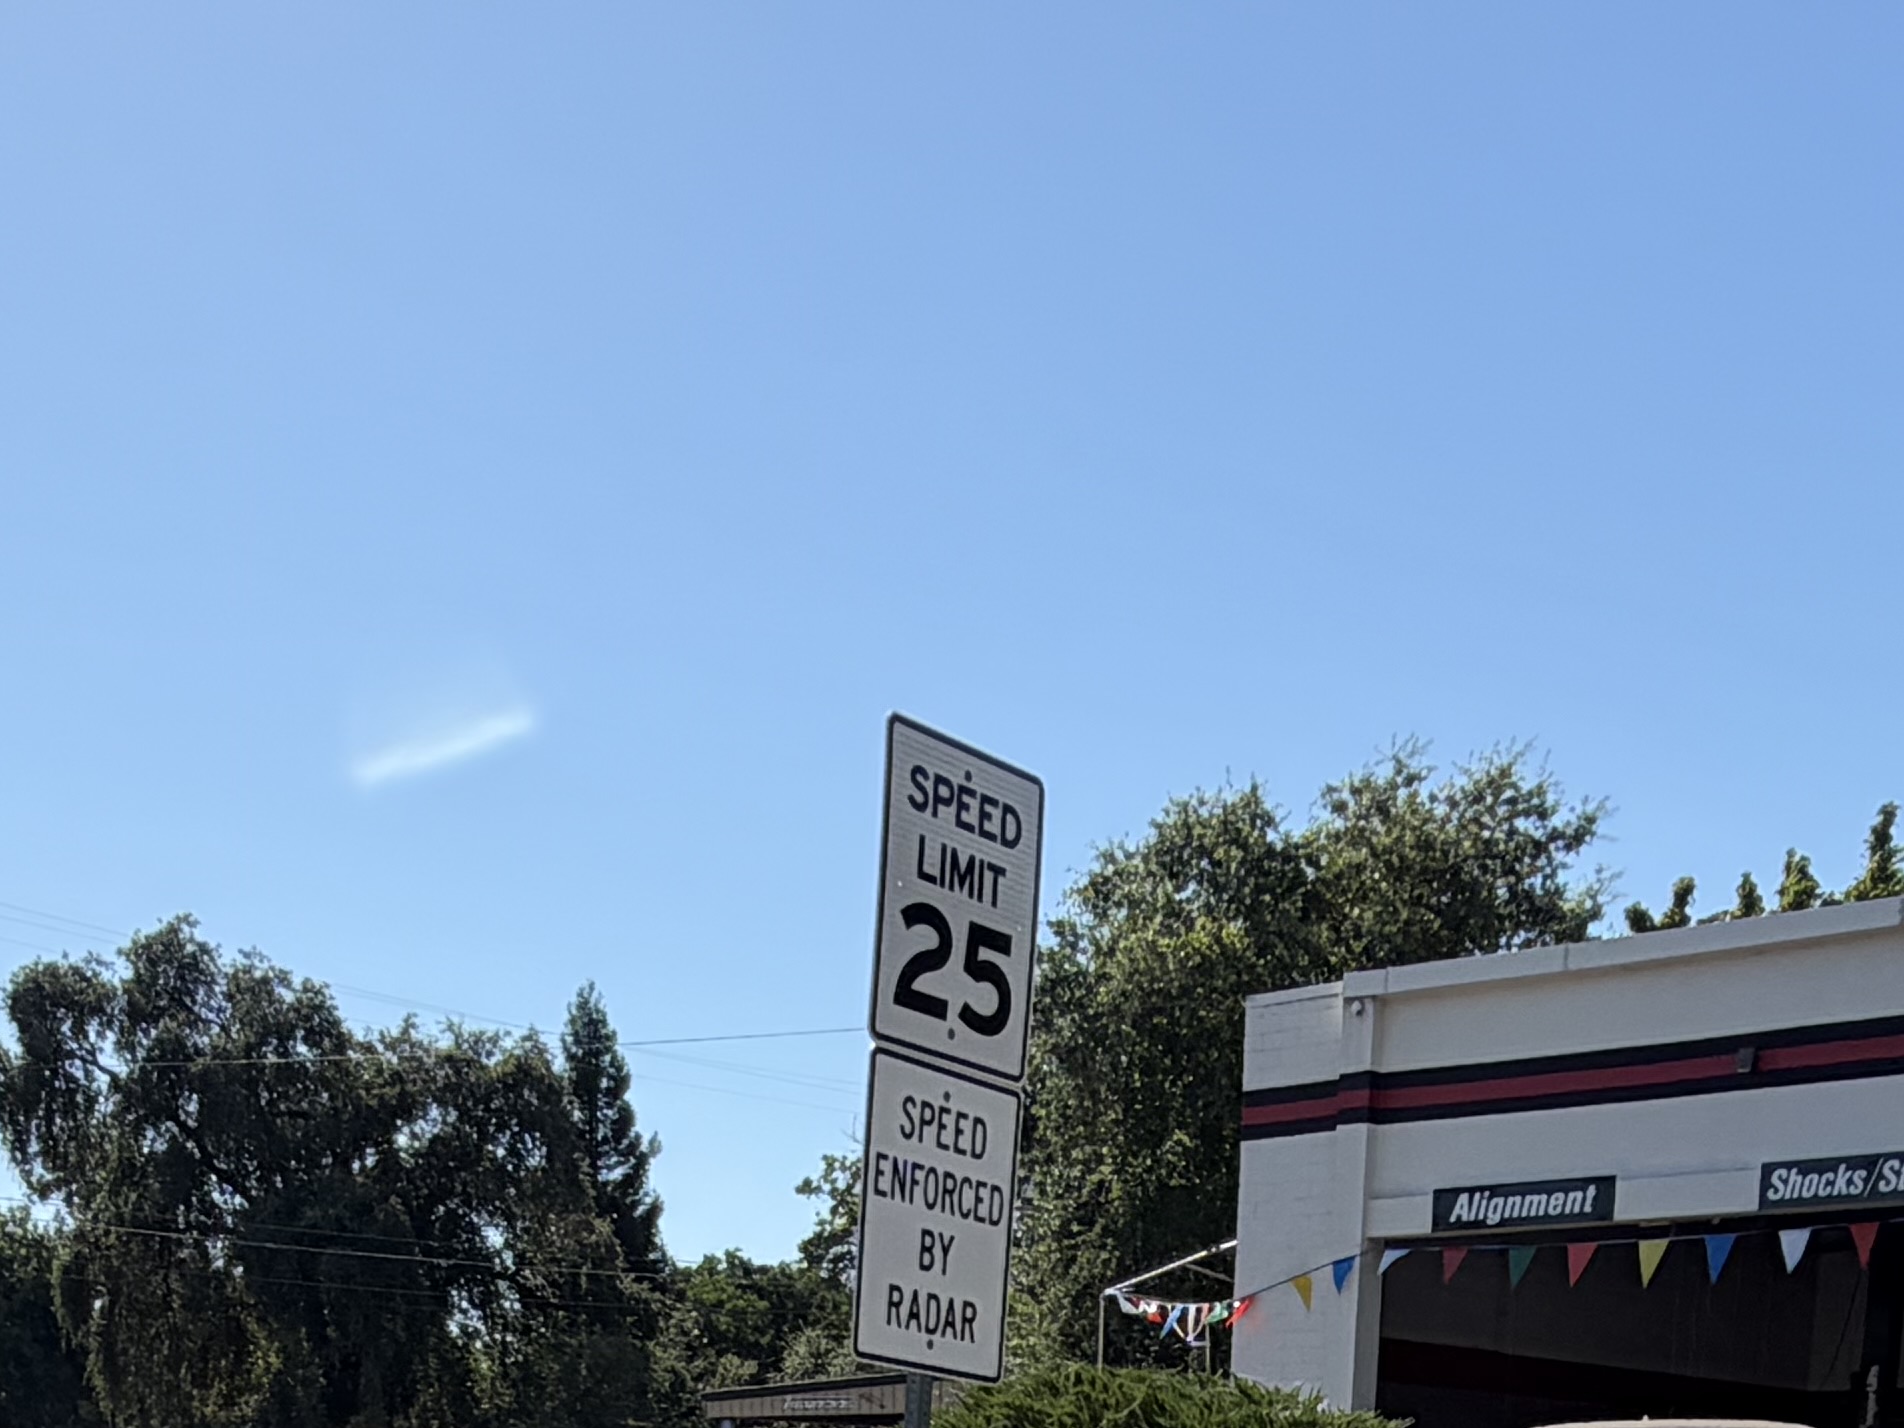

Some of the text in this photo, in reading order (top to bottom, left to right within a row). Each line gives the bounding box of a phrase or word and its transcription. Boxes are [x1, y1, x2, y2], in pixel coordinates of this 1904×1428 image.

[907, 765, 1022, 849] SPEED
[916, 834, 1007, 908] LIMIT
[892, 902, 1013, 1037] 25
[899, 1095, 988, 1160] SPEED
[873, 1152, 1004, 1227] ENFORCED
[1449, 1184, 1596, 1226] Alignment
[919, 1229, 955, 1276] BY
[886, 1283, 977, 1343] RADAR
